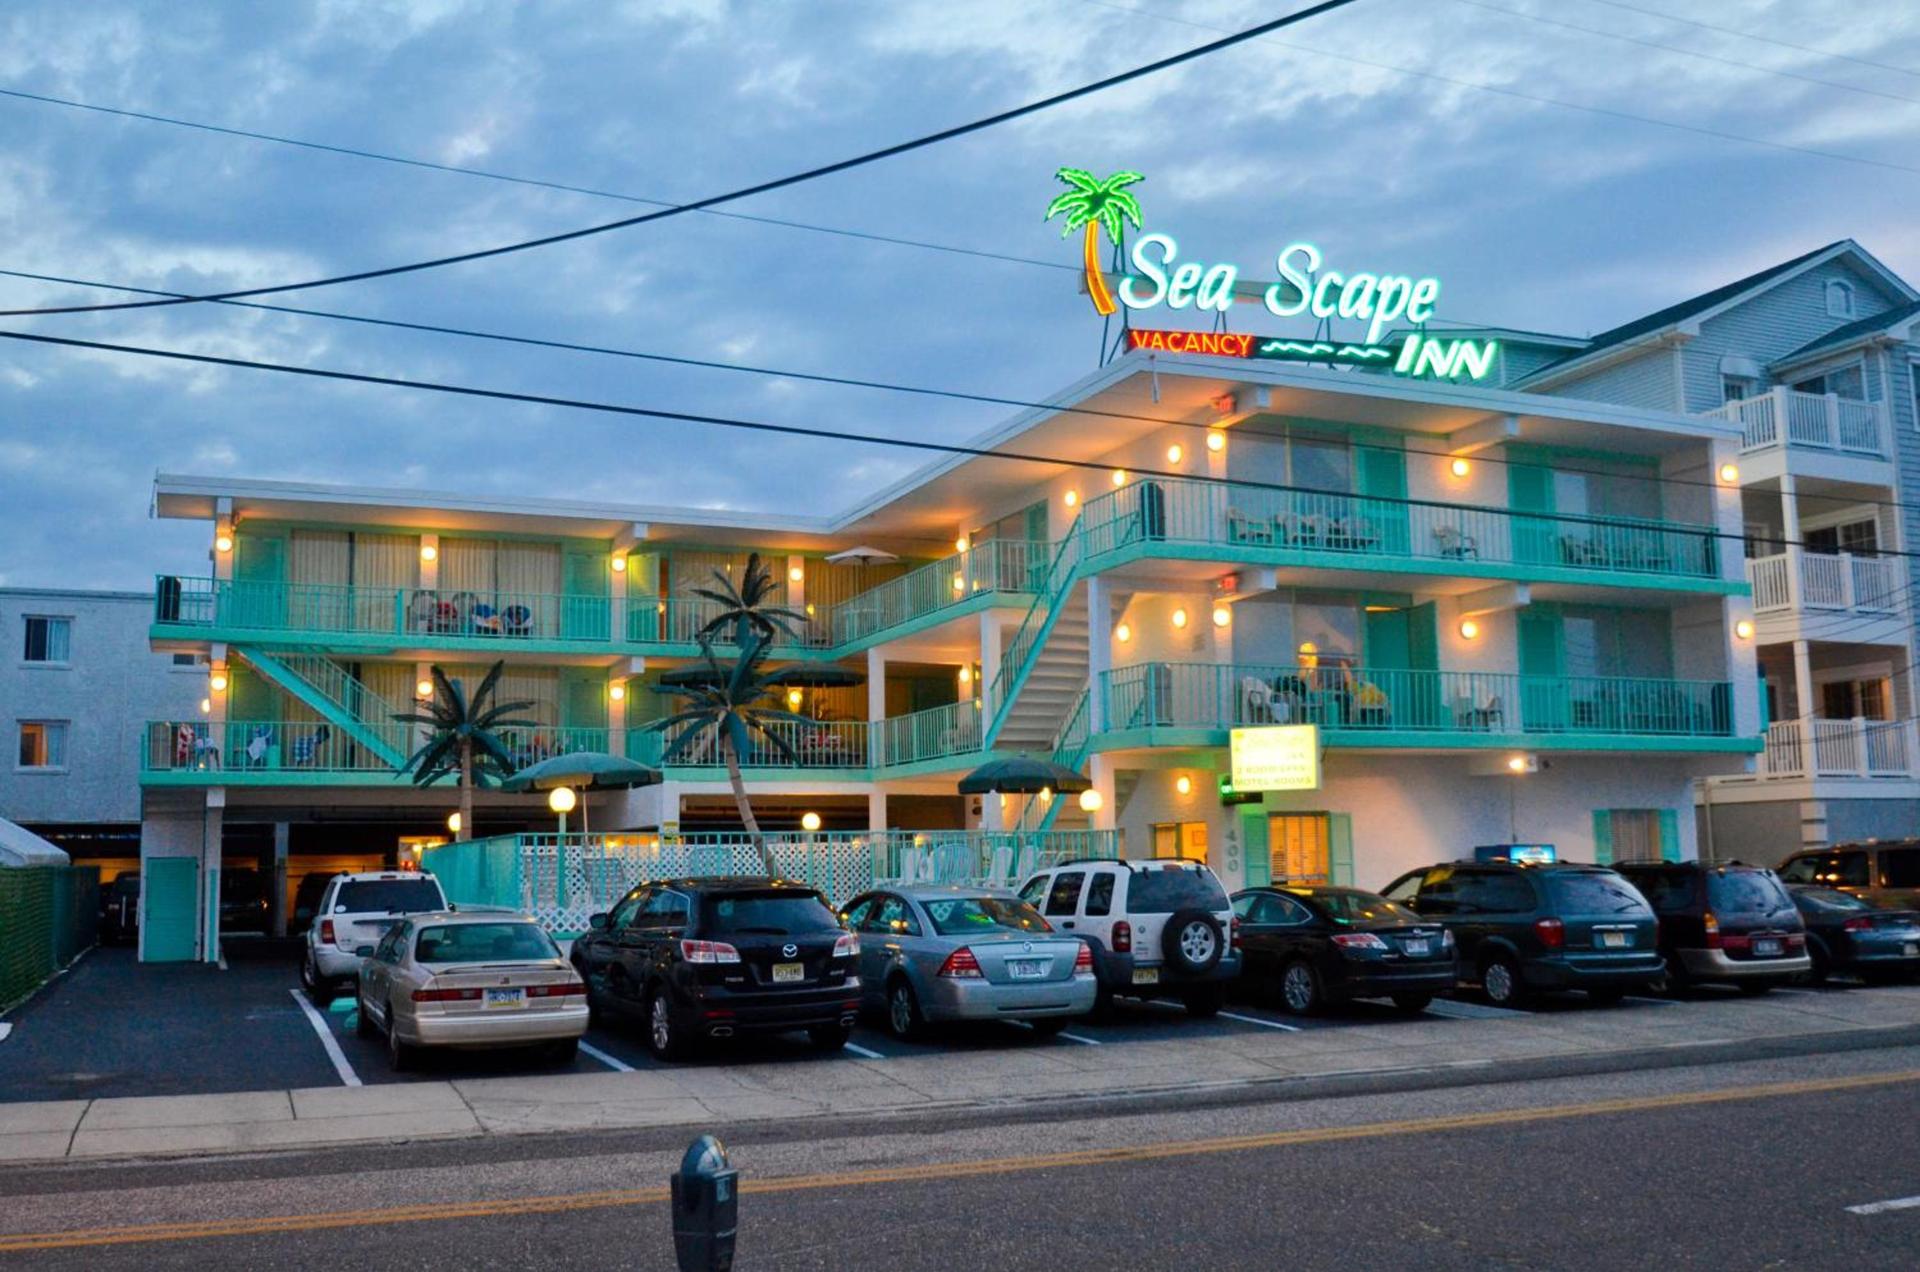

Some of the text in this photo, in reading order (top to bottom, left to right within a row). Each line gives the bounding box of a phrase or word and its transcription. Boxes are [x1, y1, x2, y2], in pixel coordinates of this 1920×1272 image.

[1118, 232, 1441, 345] Sea Scape
[1132, 330, 1255, 356] VACANCY
[1393, 333, 1497, 381] INN
